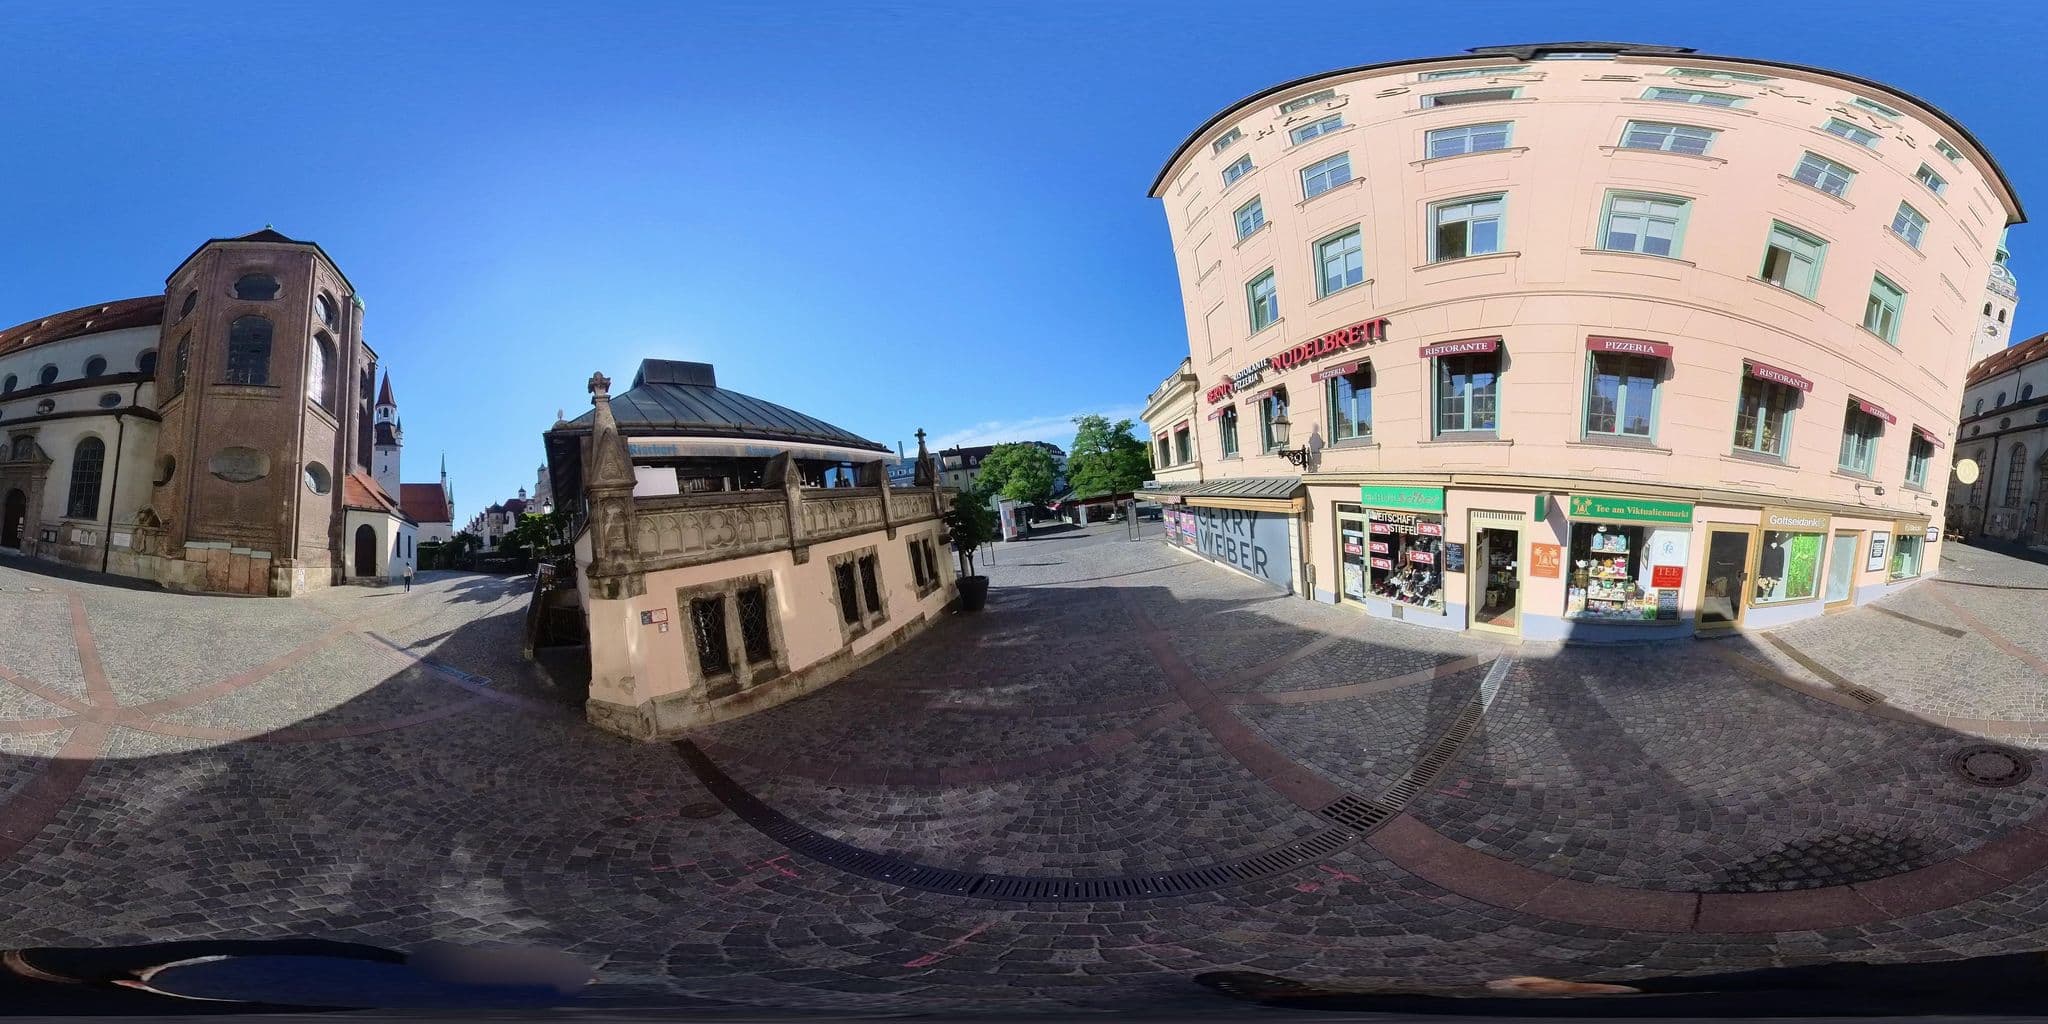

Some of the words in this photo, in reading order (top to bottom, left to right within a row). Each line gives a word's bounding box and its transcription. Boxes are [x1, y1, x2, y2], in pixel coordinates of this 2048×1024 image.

[1270, 318, 1388, 371] NUDELBRETT
[1424, 342, 1488, 356] RISTORANTE
[1605, 341, 1655, 354] PIZZERIA
[1319, 367, 1346, 380] PIZZERIA
[1759, 367, 1809, 390] RISTORANTE
[1595, 504, 1610, 513] Tee
[1627, 506, 1689, 518] Viktualienmarkt
[1770, 514, 1818, 527] Gottseidank
[1420, 525, 1438, 535] -50%
[1200, 529, 1269, 578] WEBER
[1413, 553, 1431, 562] -50%
[1657, 568, 1680, 576] TEE
